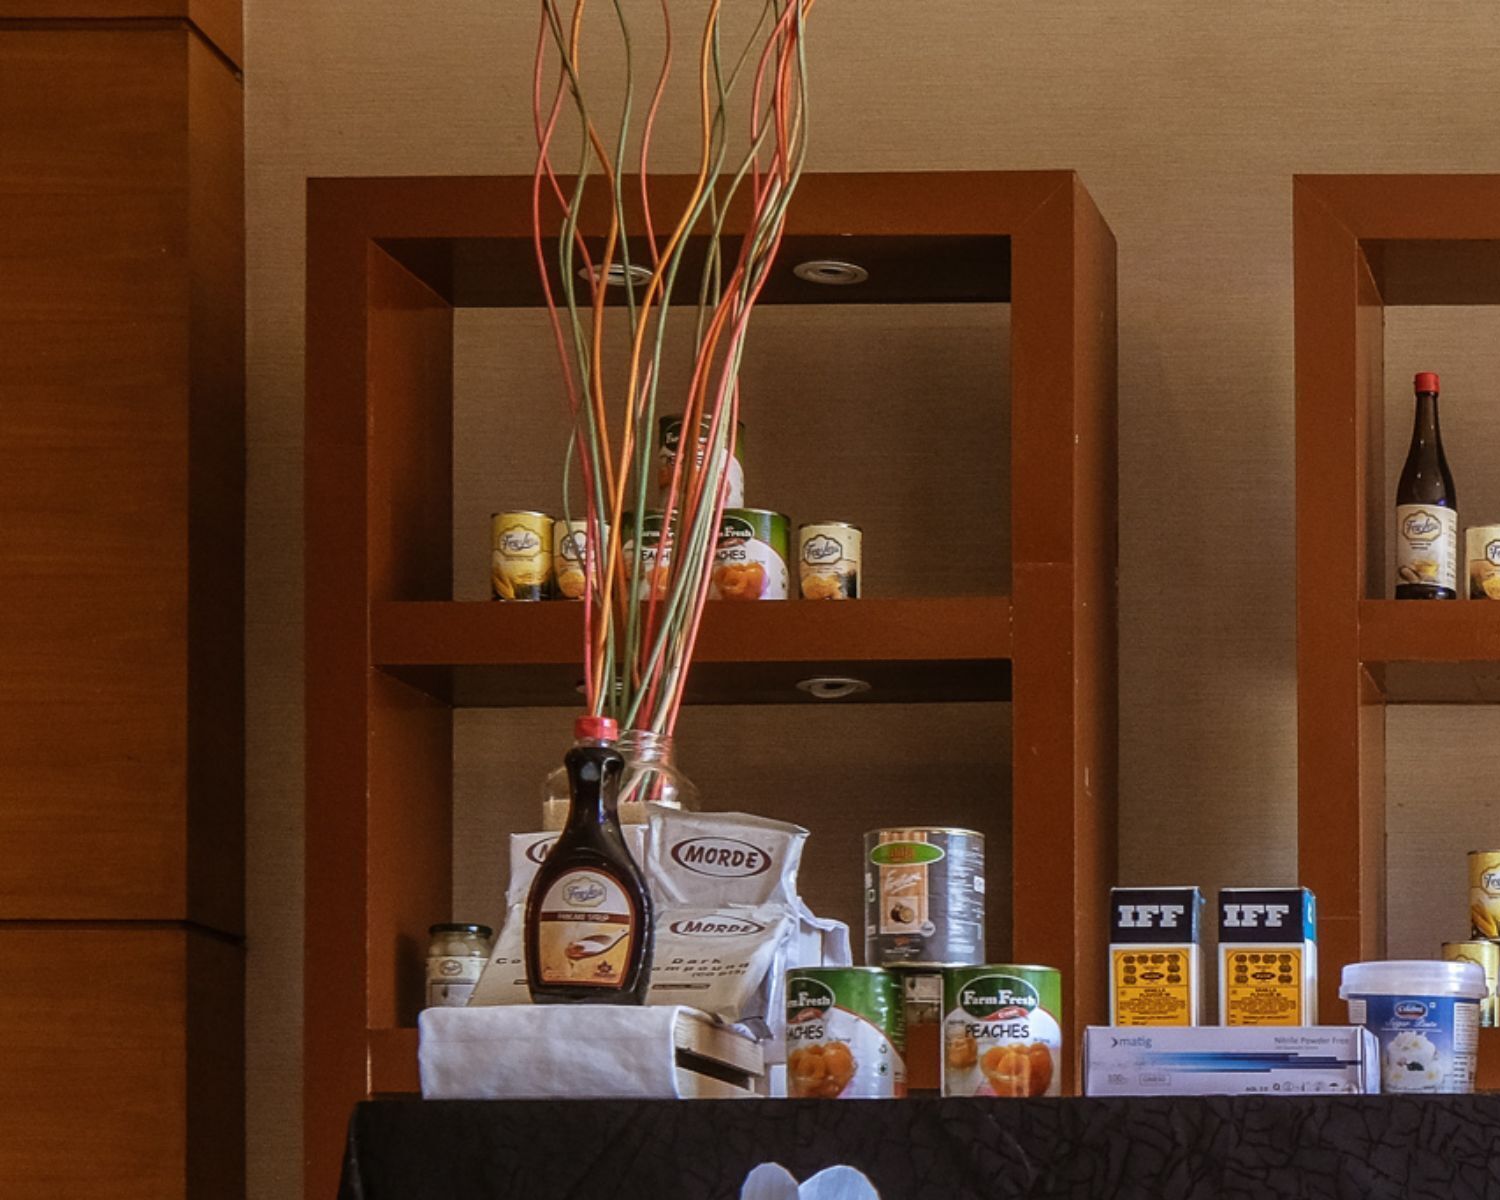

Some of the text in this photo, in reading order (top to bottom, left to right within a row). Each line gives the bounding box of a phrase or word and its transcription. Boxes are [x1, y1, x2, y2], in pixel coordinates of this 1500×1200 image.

[685, 846, 758, 869] MORDE
[1118, 904, 1184, 927] IFF
[1223, 904, 1289, 927] IFF
[683, 920, 750, 933] MORDE
[652, 962, 750, 971] ompound
[798, 991, 831, 1006] Fresh
[963, 989, 1036, 1005] Farm Fresh
[965, 1023, 1030, 1038] PEACHES
